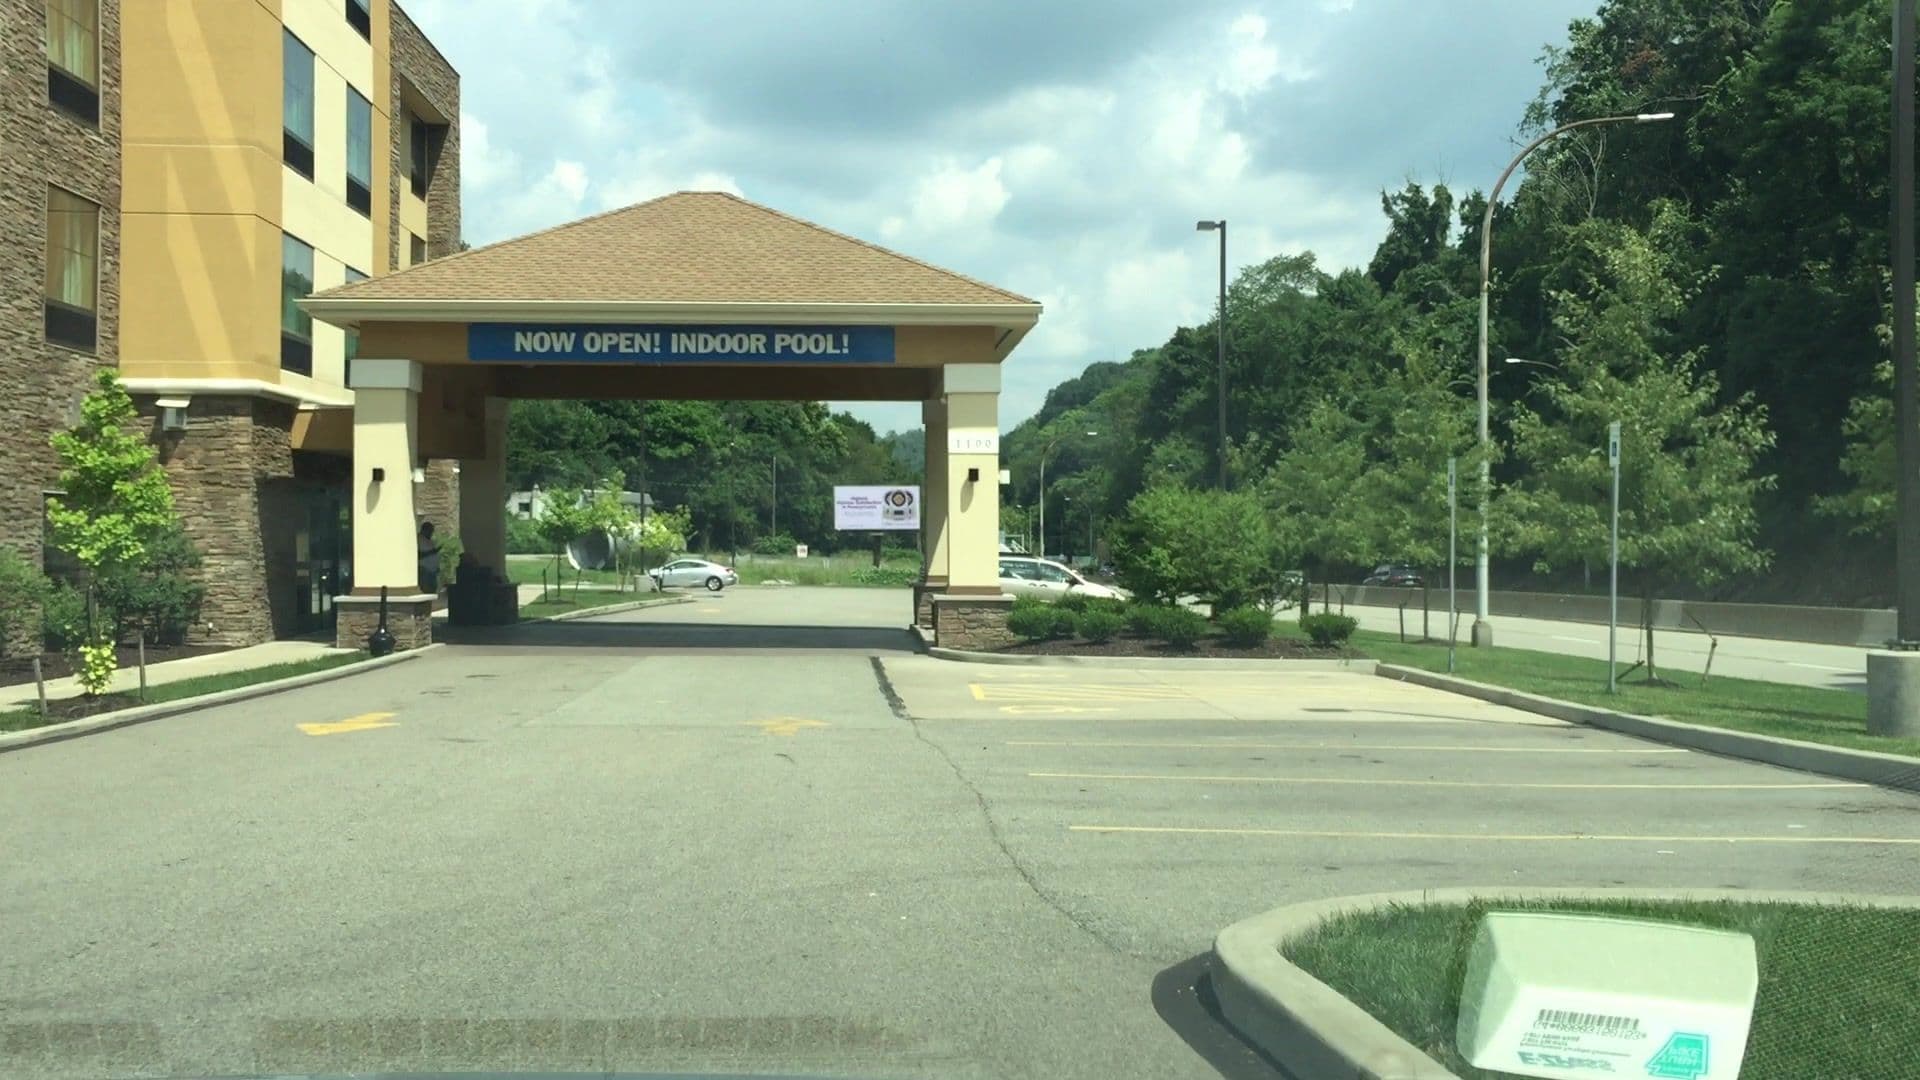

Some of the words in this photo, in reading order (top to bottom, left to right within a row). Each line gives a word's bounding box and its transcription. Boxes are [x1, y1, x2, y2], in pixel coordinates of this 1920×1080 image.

[514, 331, 576, 353] NOW
[583, 331, 661, 353] OPEN!
[671, 331, 766, 354] INDOOR
[774, 332, 851, 354] POOL!
[956, 439, 993, 450] 1100
